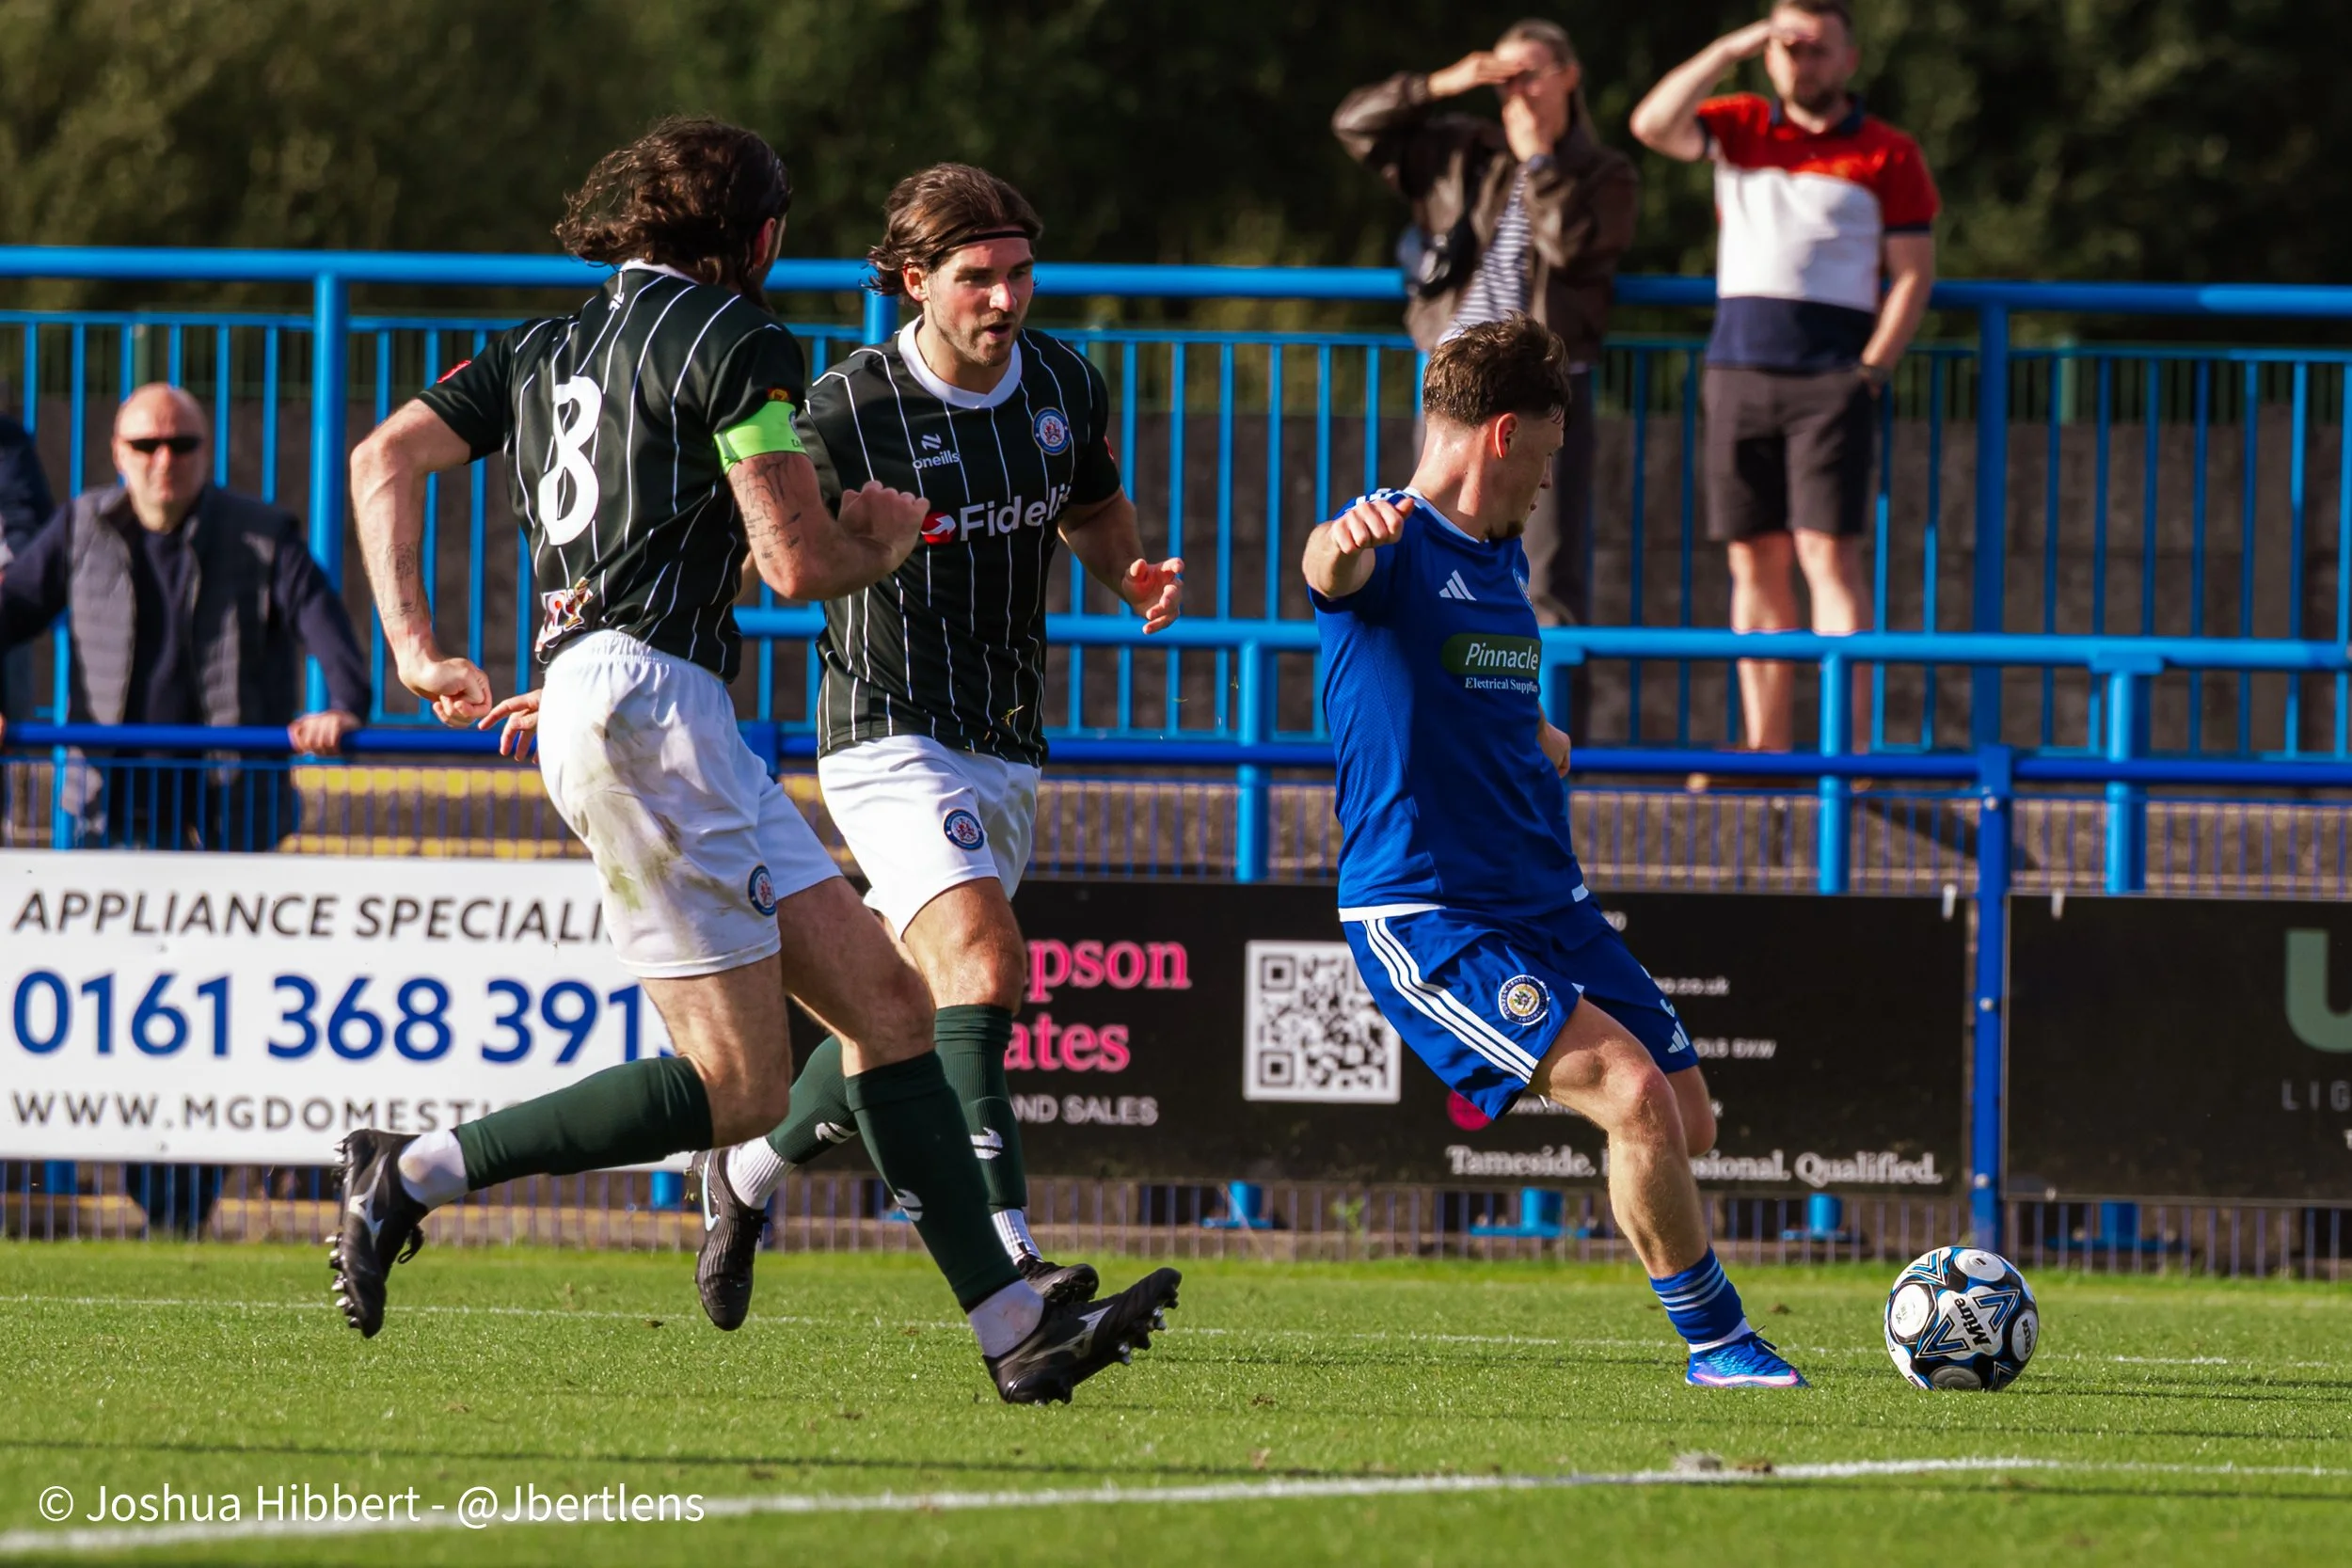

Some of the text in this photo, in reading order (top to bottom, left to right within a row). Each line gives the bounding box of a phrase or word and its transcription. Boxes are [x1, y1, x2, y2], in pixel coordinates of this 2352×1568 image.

[538, 376, 602, 546] 8
[912, 450, 961, 470] oneills
[1465, 642, 1538, 671] Pinnacle
[1465, 677, 1509, 690] Electrical
[12, 890, 613, 944] APPLIANCE SPECIALI
[1025, 939, 1191, 1003] pson
[13, 970, 674, 1067] 0161 368 391
[1004, 1013, 1131, 1072] ates
[1012, 1093, 1159, 1126] ND SALES
[2281, 1079, 2350, 1112] LIG
[1445, 1144, 1597, 1179] Tameside.
[1794, 1150, 1944, 1190] Qualified.
[1954, 1297, 1992, 1346] Mitre
